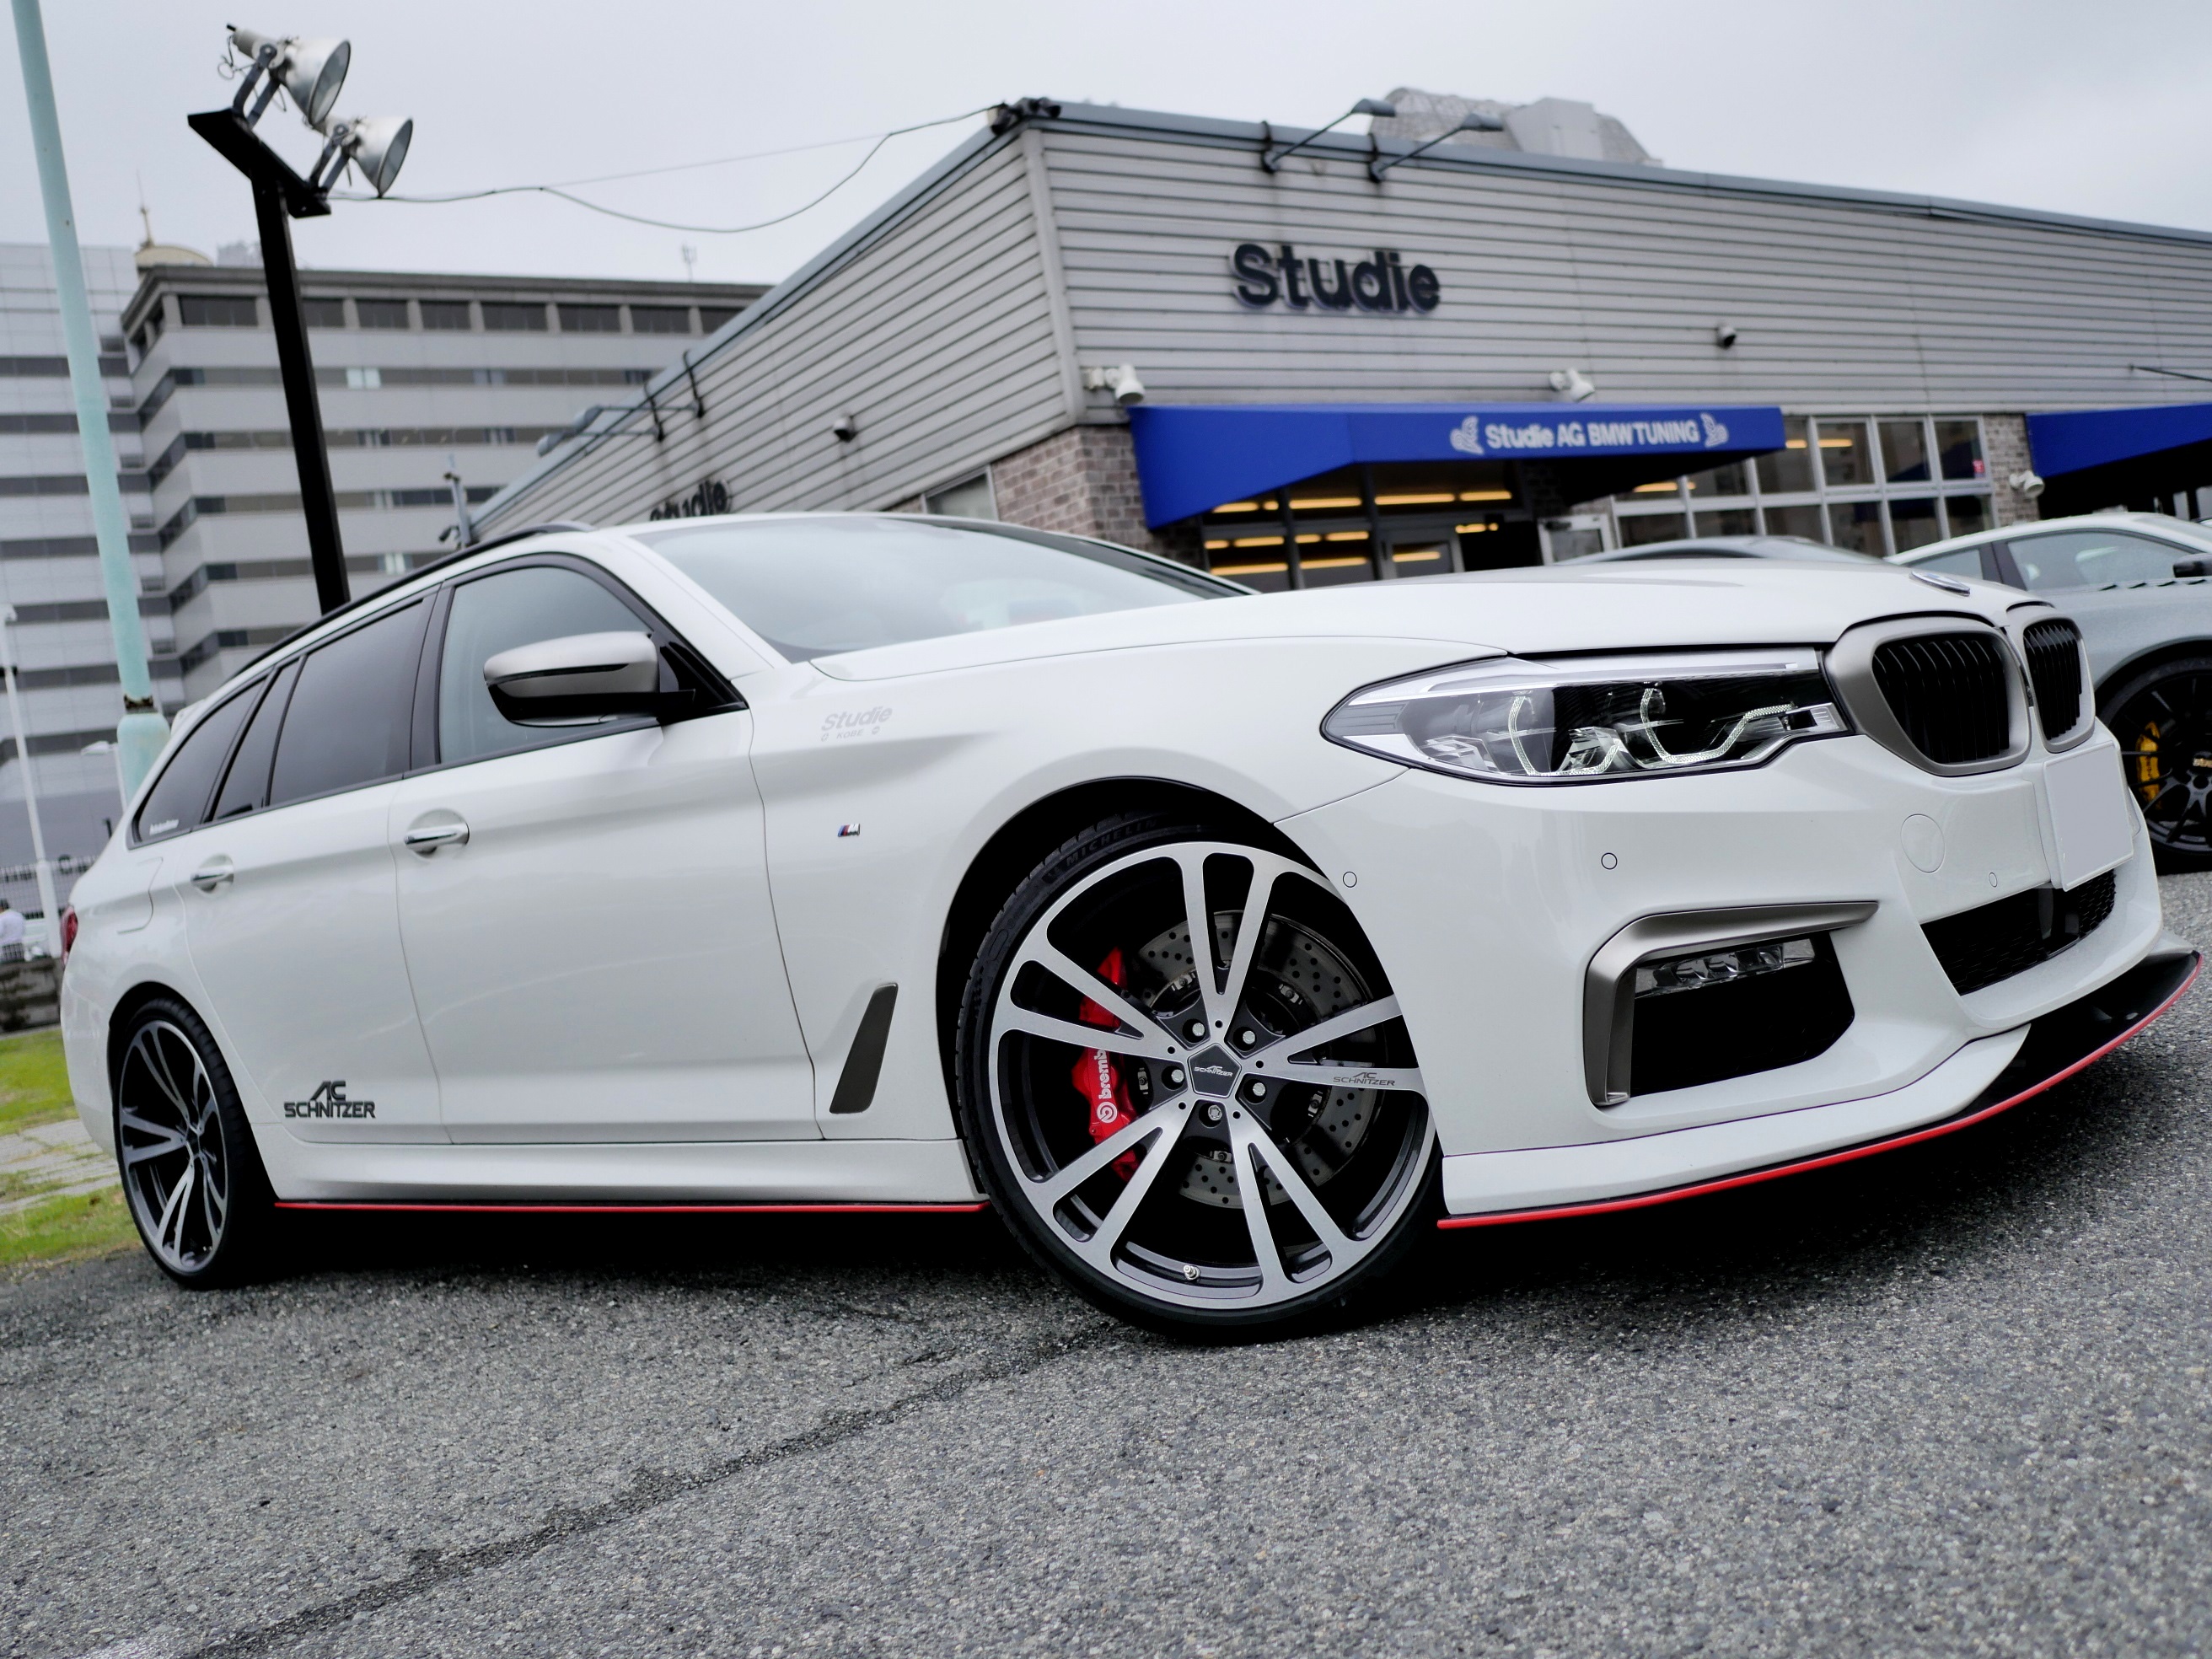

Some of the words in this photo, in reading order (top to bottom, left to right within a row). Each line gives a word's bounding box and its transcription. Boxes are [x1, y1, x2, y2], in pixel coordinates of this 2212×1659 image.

[1232, 243, 1441, 314] Studie
[1485, 423, 1555, 449] Studie
[1557, 421, 1587, 448] AG
[821, 706, 894, 732] Studie
[836, 728, 864, 739] KOBE
[1066, 818, 1159, 867] MICHELIN
[1093, 1050, 1112, 1099] bremb
[1333, 1076, 1396, 1087] SCHNITZER
[309, 1080, 346, 1102] AC
[283, 1101, 376, 1119] SCHNITZER
